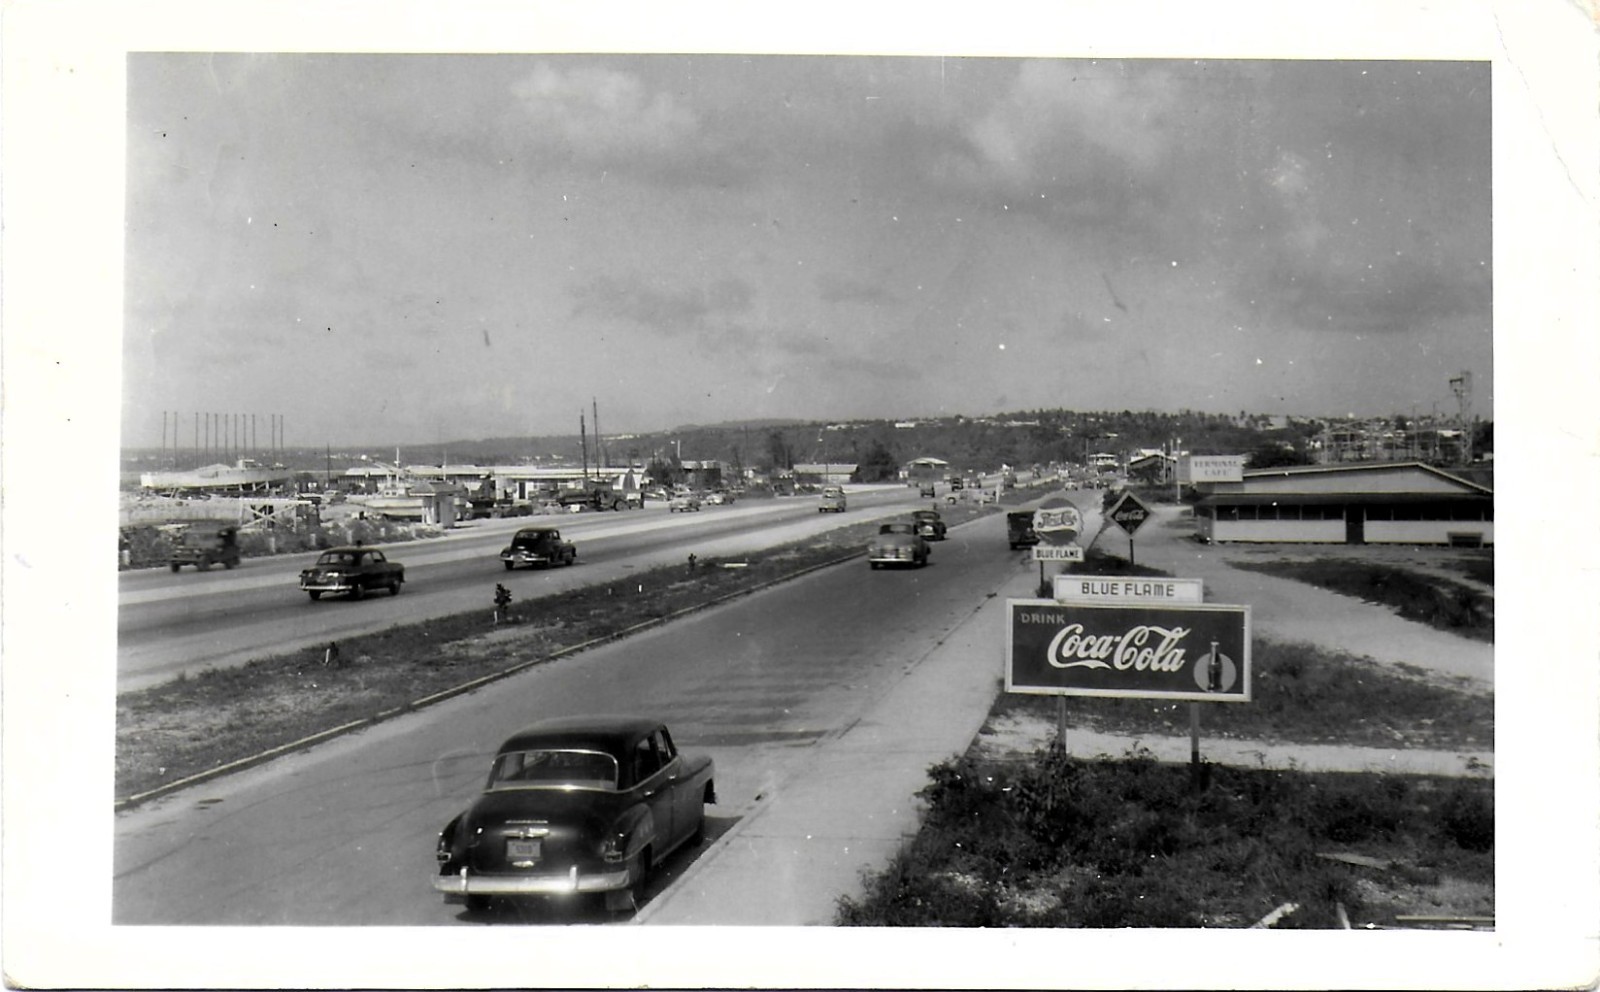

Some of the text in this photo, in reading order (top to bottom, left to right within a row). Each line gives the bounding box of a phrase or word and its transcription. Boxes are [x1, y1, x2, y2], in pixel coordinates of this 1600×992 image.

[1036, 549, 1079, 559] BLUE FLAME
[1081, 581, 1175, 597] BLUE FLAME
[1020, 613, 1066, 624] DRINK
[1047, 623, 1192, 672] Coca-Cola
